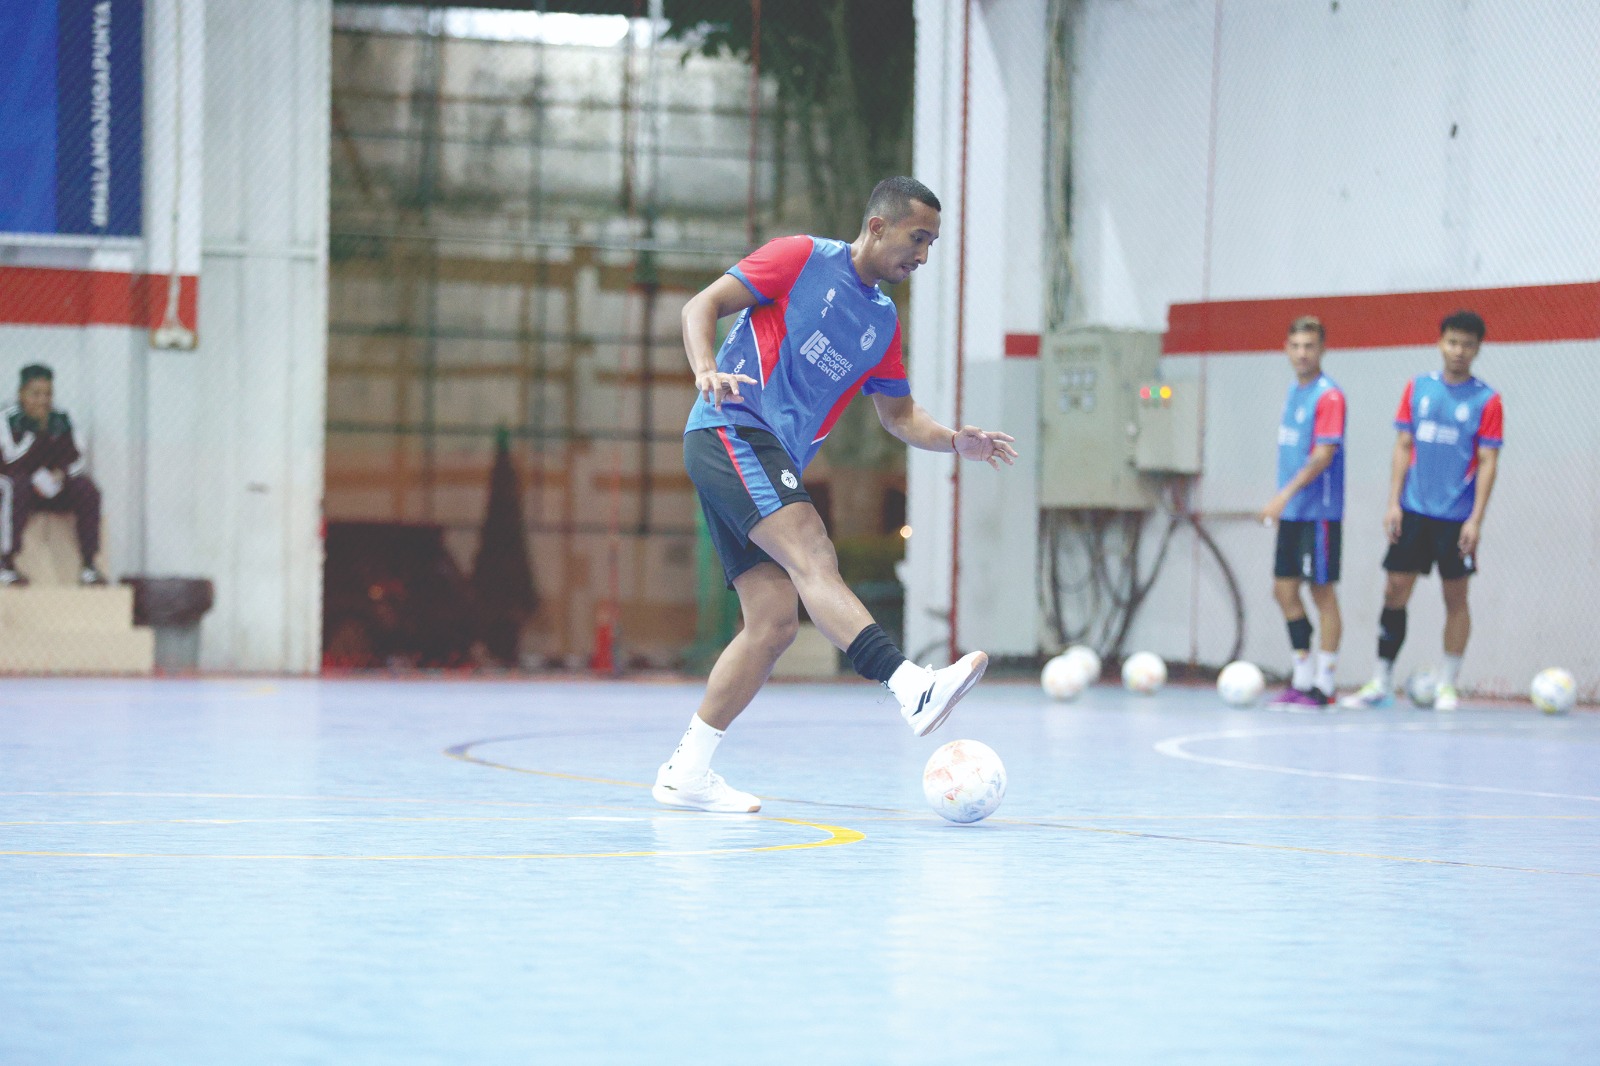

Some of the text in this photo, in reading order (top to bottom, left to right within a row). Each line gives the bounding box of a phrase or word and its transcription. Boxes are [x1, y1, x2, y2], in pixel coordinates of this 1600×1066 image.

[821, 306, 828, 318] 4
[822, 354, 847, 376] SPORTS
[826, 346, 853, 371] UNGGUL
